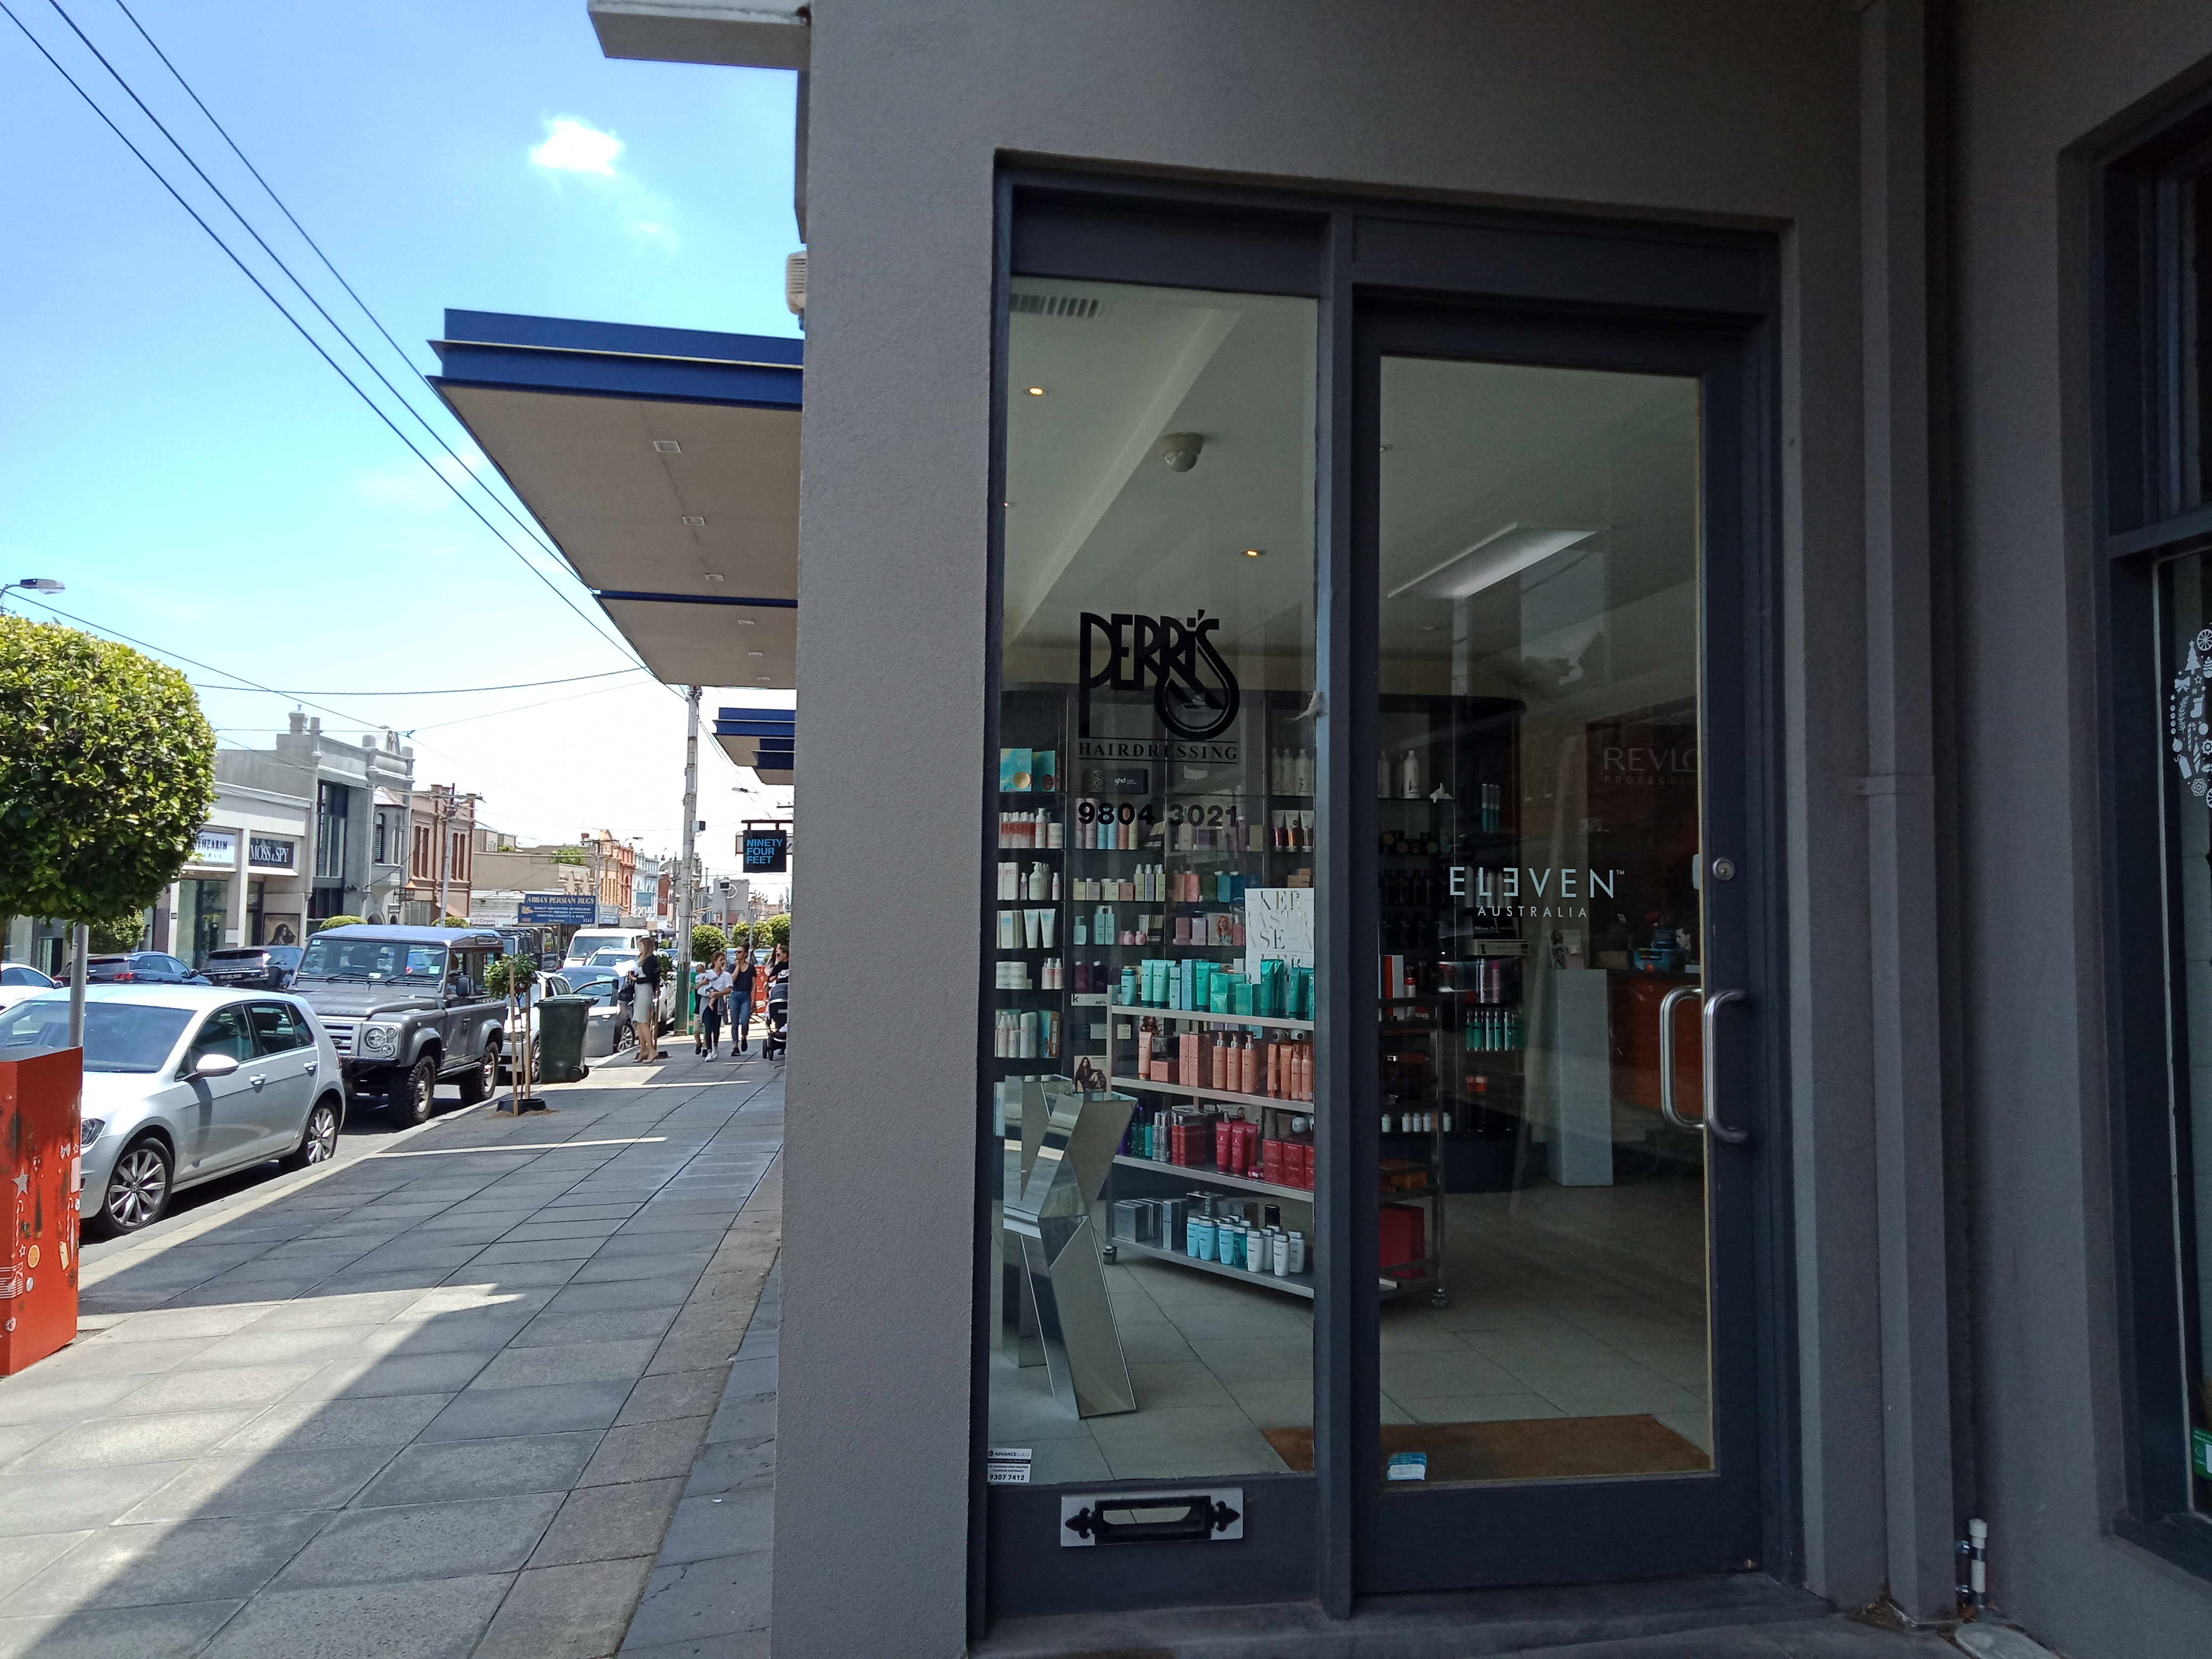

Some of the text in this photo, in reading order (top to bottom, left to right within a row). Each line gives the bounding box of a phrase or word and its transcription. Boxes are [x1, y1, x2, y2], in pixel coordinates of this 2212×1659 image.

[1078, 743, 1238, 760] HAIRDRESSING
[1078, 802, 1237, 827] 9804 3021
[747, 839, 783, 847] NINETY
[249, 844, 271, 861] MOSS
[275, 847, 289, 862] SPY
[747, 856, 773, 864] FEET
[1449, 867, 1614, 899] ELEVEN
[1477, 905, 1587, 918] AUSTRALIA
